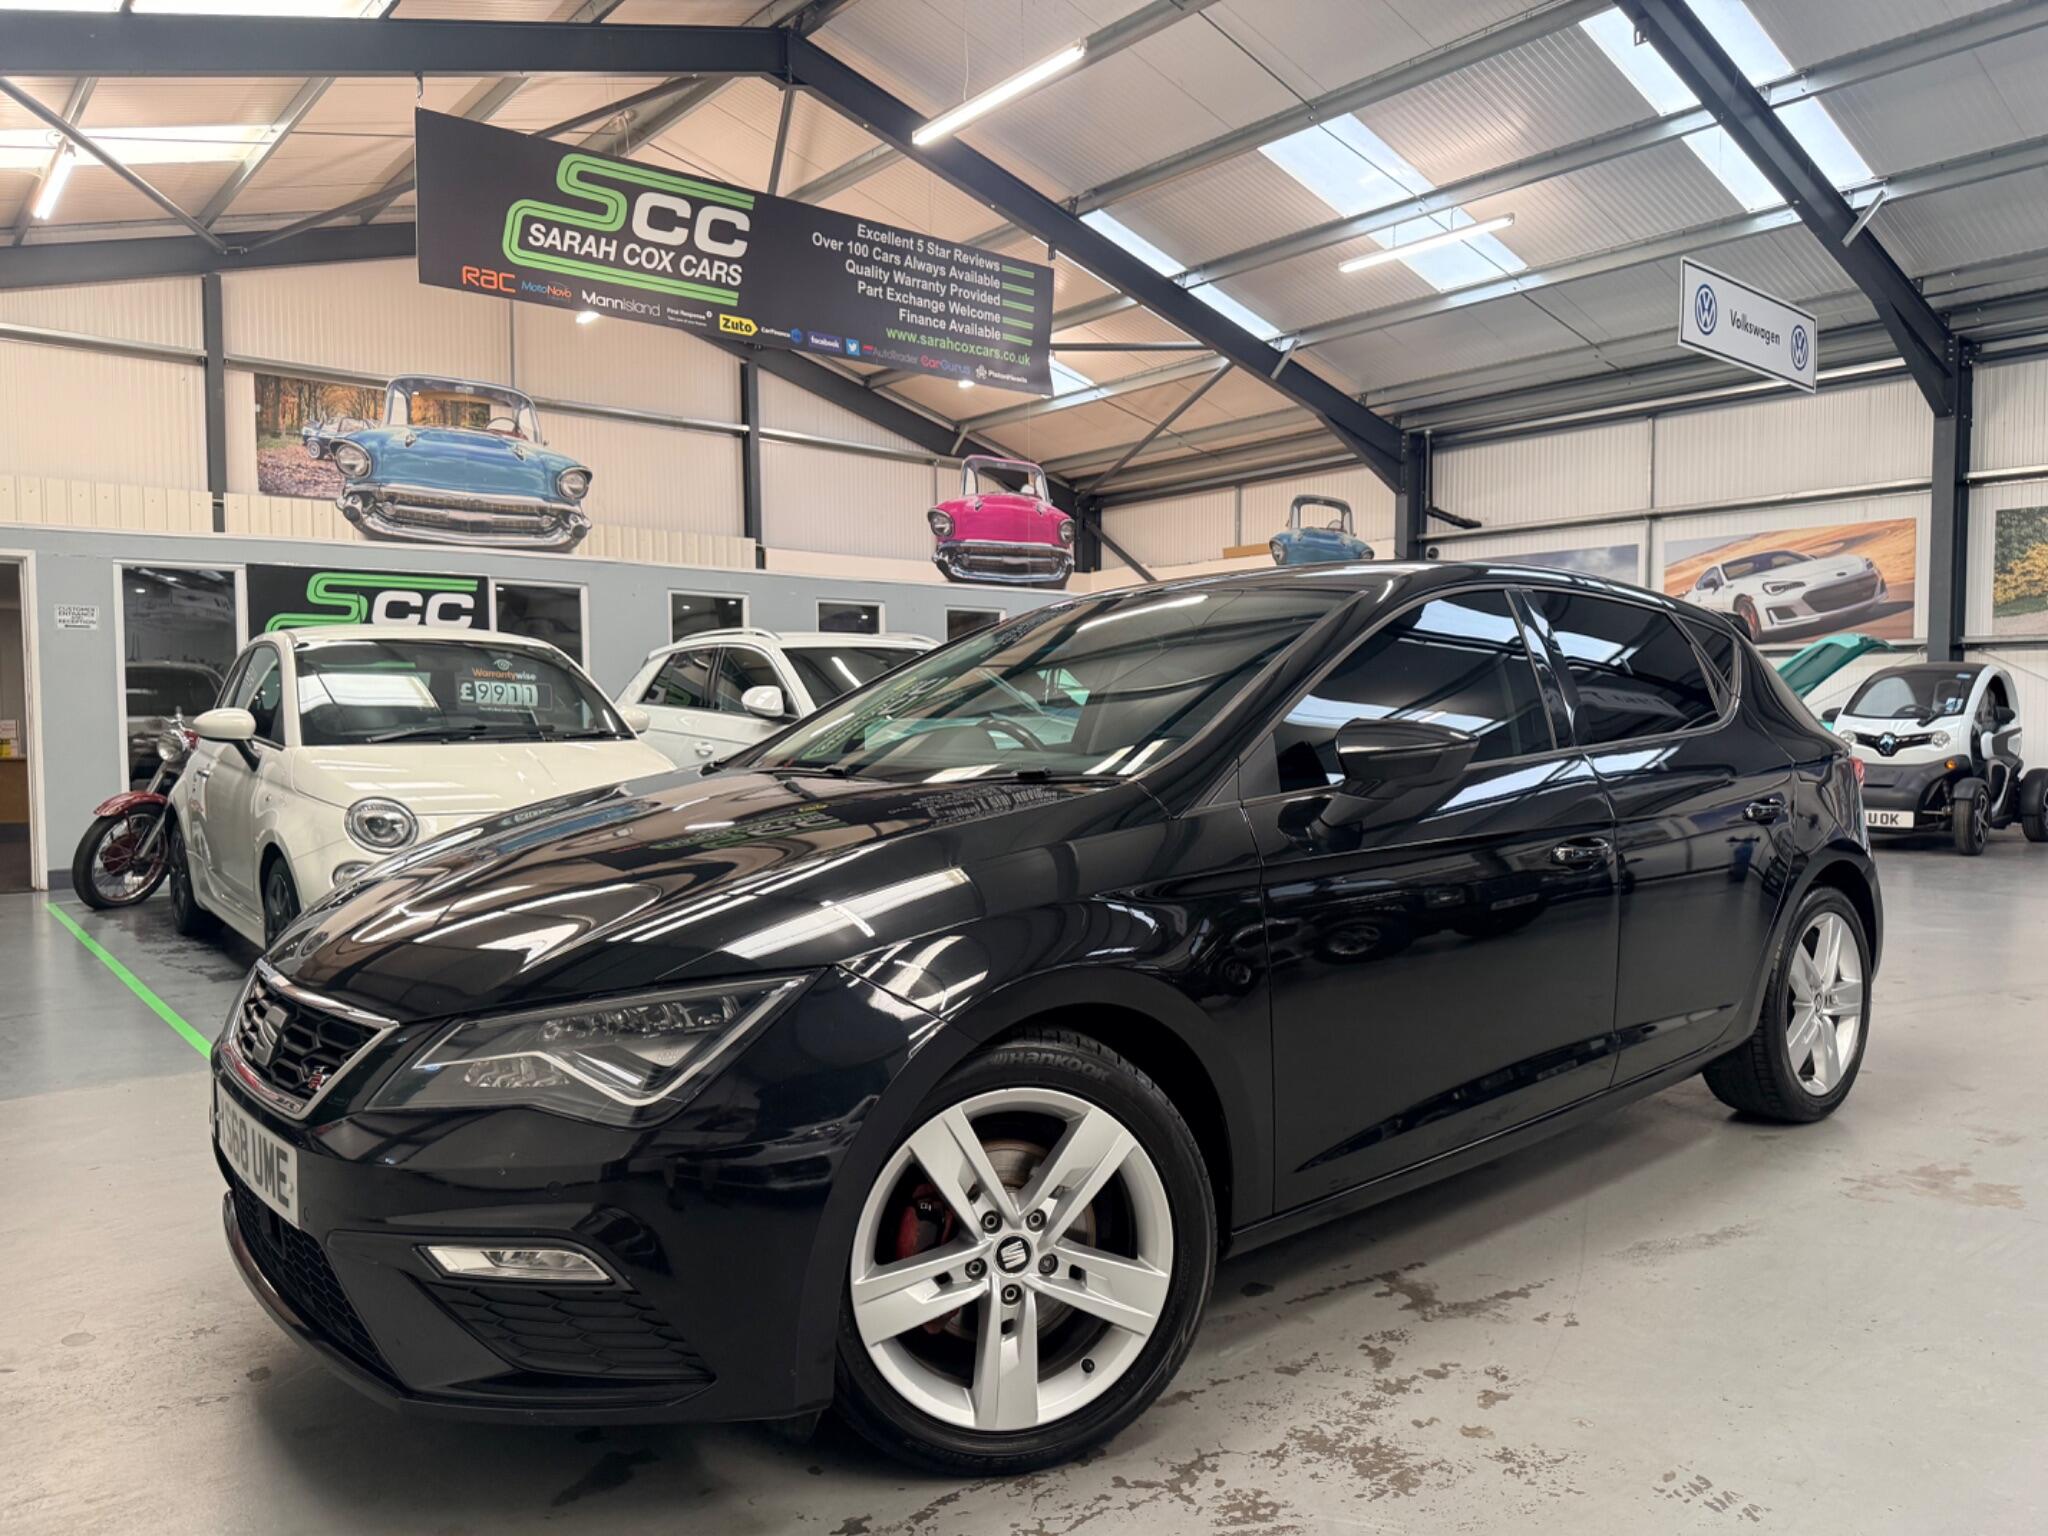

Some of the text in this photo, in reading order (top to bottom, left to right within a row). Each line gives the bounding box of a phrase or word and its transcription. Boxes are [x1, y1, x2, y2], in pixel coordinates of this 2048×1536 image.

[528, 223, 743, 286] SARAH COX CARS
[812, 232, 1000, 289] Over 100 Cars Always Available
[857, 223, 1000, 272] Excellent 5 Star Reviews
[845, 258, 1000, 307] Quality Warranty Provided
[857, 281, 1001, 324] Part Exchange Welcome
[722, 316, 753, 334] Zuto
[920, 355, 972, 376] CarGurus
[886, 327, 1031, 367] www.sarahcoxcars.co.uk
[898, 308, 1001, 341] Finance Available
[1729, 308, 1781, 346] Volkswagen
[472, 666, 537, 681] Warrantywise
[252, 1128, 289, 1209] UME
